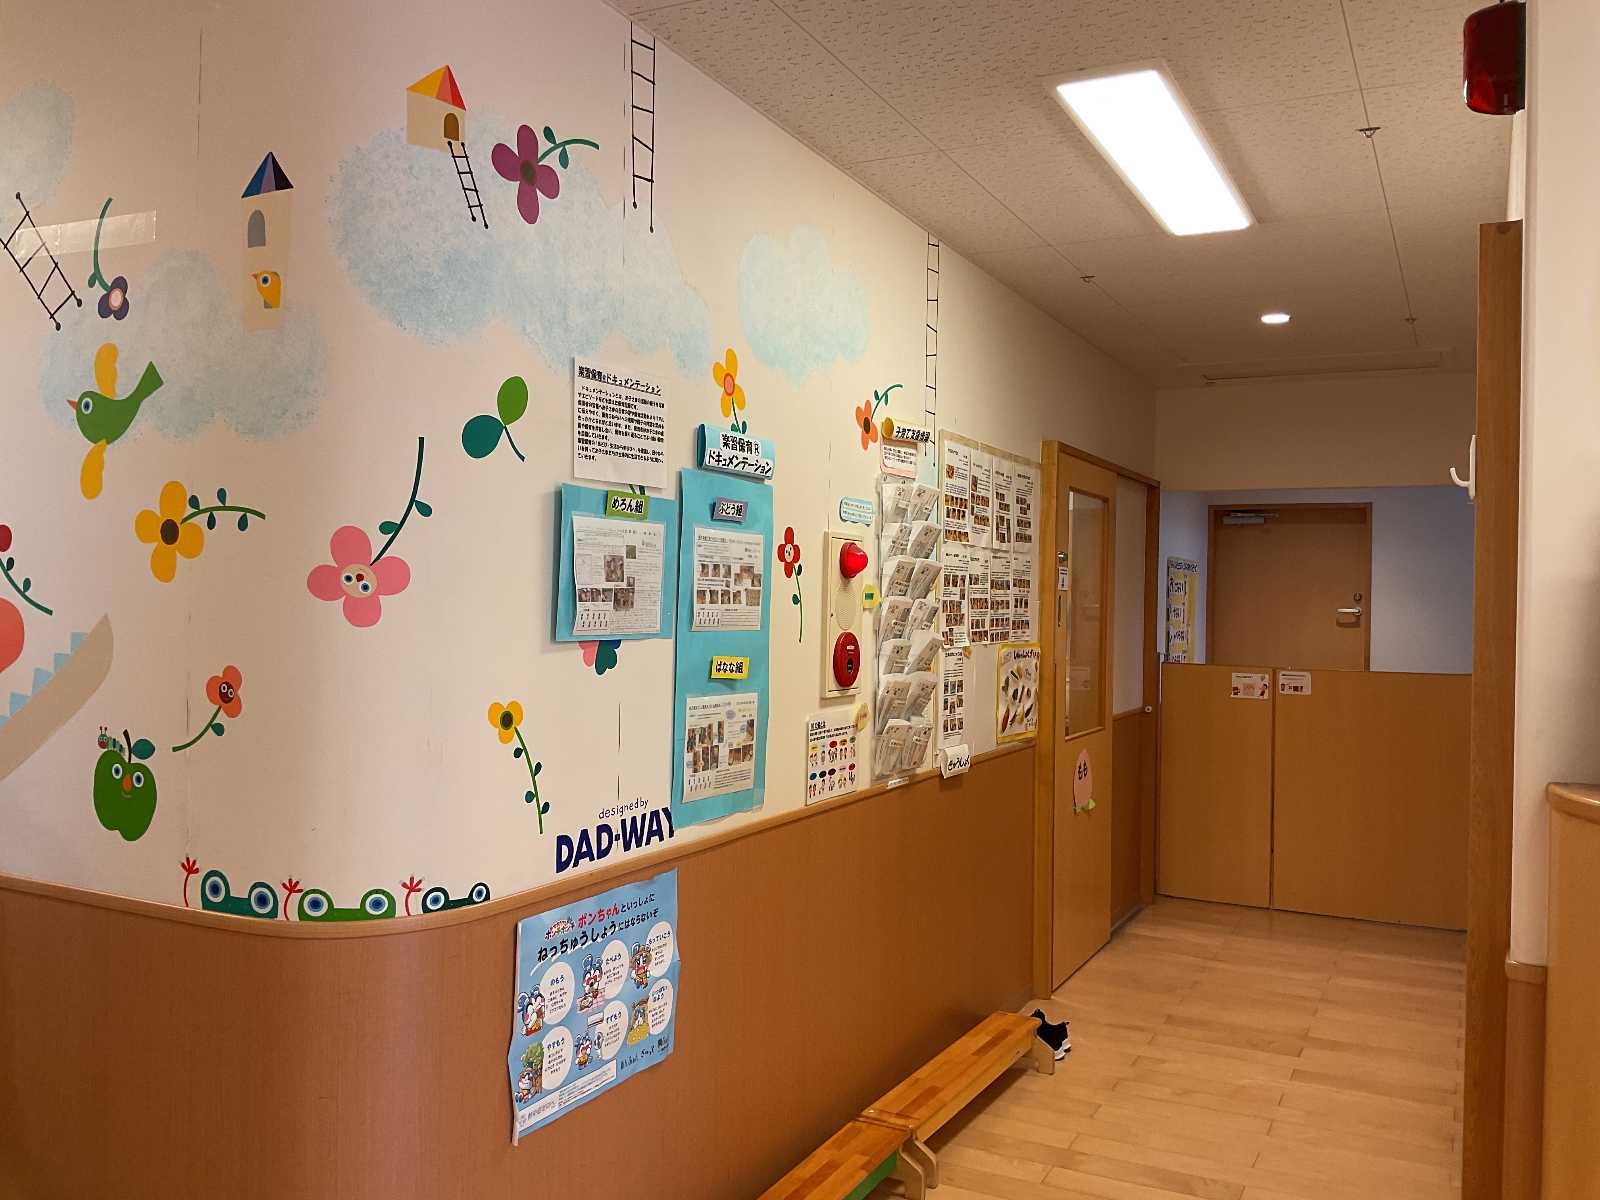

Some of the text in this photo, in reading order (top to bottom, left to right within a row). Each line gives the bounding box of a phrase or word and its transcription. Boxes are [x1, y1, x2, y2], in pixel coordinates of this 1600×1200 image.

[709, 449, 772, 475] ドキュメンテーション
[612, 496, 643, 513] めろん組
[719, 502, 743, 516] ぶどう組
[598, 797, 649, 819] designed by
